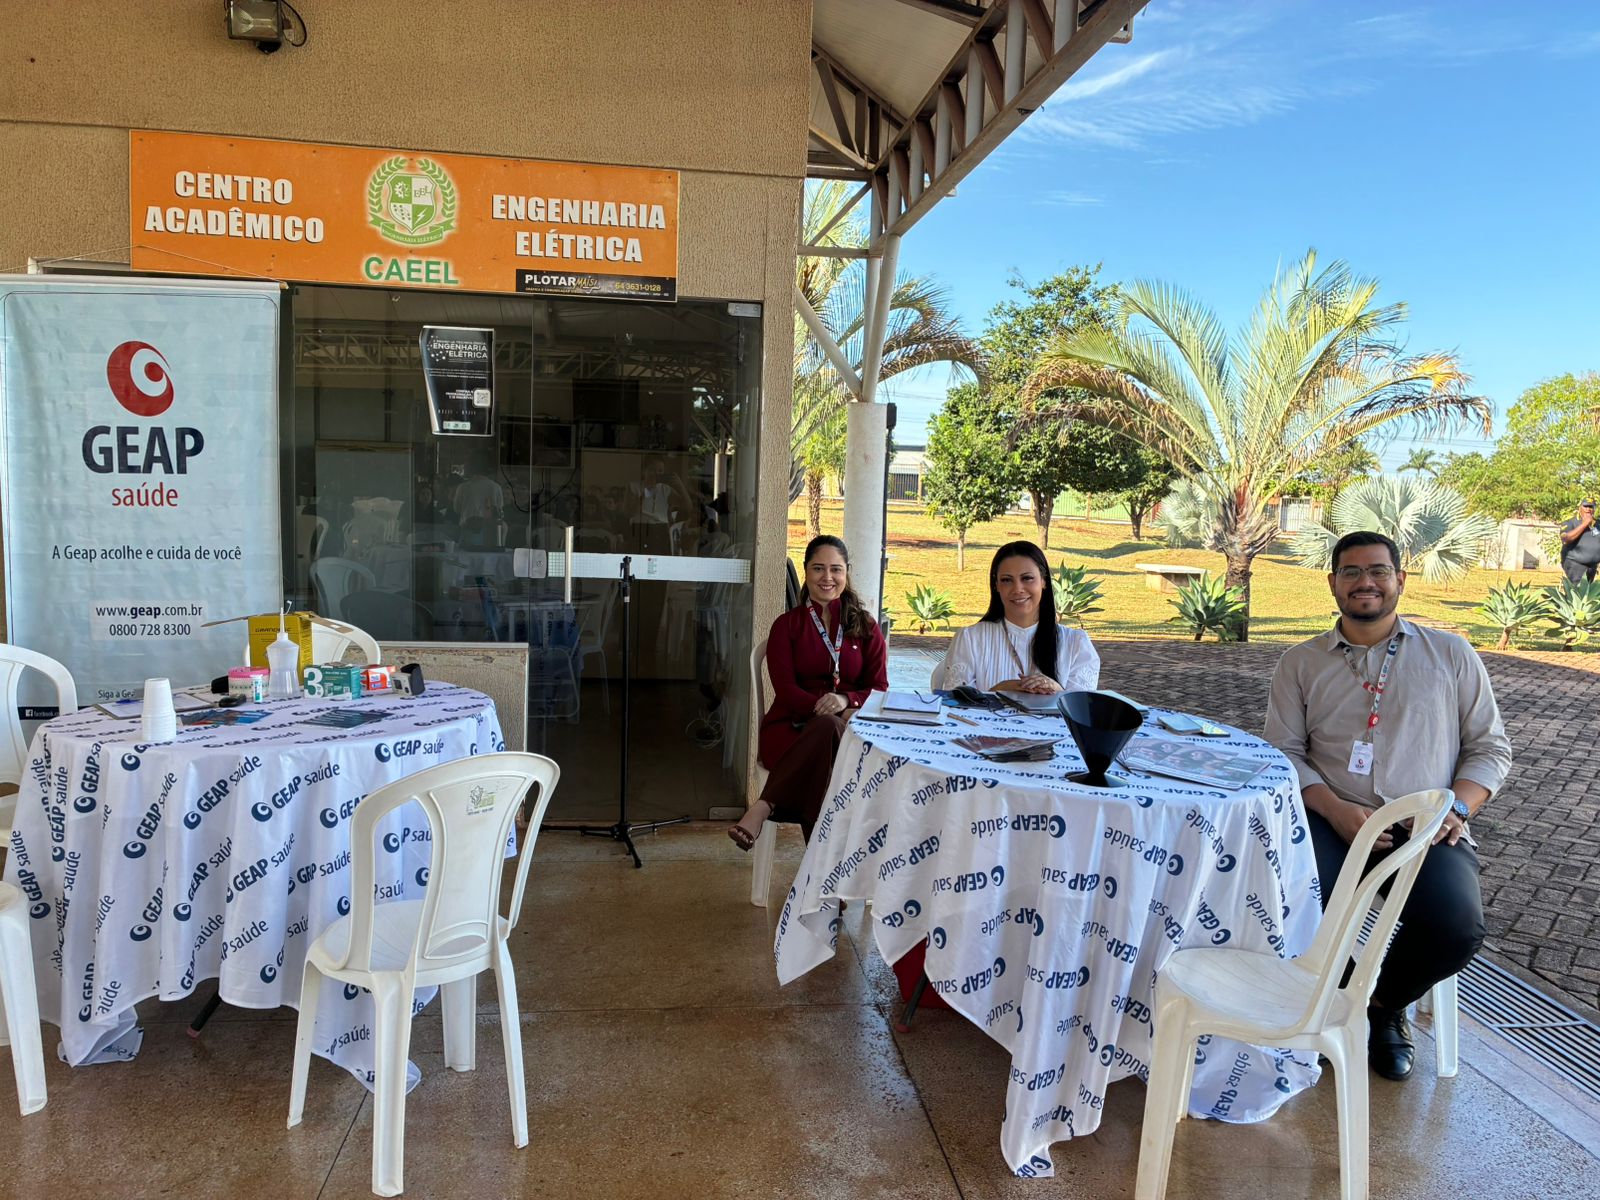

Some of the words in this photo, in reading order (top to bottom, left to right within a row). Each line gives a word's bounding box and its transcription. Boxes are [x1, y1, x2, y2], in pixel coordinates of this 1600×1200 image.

[175, 170, 293, 204] CENTRO
[144, 206, 324, 243] ACADÊMICO
[492, 194, 666, 229] ENGENHARIA
[516, 229, 643, 263] ELÉTRICA
[364, 256, 459, 284] CAEEL
[525, 274, 576, 286] PLOTAR
[433, 342, 487, 351] ENGENHARIA
[449, 349, 488, 358] ELÉTRICA
[82, 425, 204, 475] GEAP
[111, 482, 178, 507] saúde
[52, 546, 61, 560] A
[64, 545, 97, 562] Geap
[100, 545, 142, 560] acolhe
[146, 549, 153, 560] e
[157, 545, 191, 560] cuida
[194, 545, 210, 560] de
[214, 546, 242, 560] você
[96, 603, 203, 619] www.geap.com.br
[109, 624, 137, 636] 0800
[140, 624, 160, 636] 728
[163, 624, 191, 636] 8300
[98, 689, 114, 700] Siga
[304, 667, 325, 698] 3
[393, 739, 421, 757] GEAP
[54, 765, 69, 806] saúde
[196, 779, 231, 813] GEAP
[229, 755, 263, 786] saúde
[271, 775, 302, 810] GEAP
[304, 761, 341, 787] saúde
[861, 766, 888, 800] saúde
[911, 781, 944, 806] saúde
[945, 775, 977, 795] GEAP
[339, 794, 369, 820] GEA
[51, 805, 66, 843] GEAP
[136, 803, 161, 840] GEAP
[411, 826, 432, 842] saú
[971, 815, 1009, 839] saúde
[1011, 814, 1050, 832] GEAP
[11, 830, 31, 867] saúde
[909, 835, 941, 866] GEAP
[1103, 826, 1144, 853] saúde
[64, 850, 82, 891] saúde
[232, 858, 269, 892] GEAP
[878, 853, 907, 881] saúd
[1041, 866, 1067, 887] saú
[18, 868, 43, 901] GEAP
[187, 861, 210, 902] GEAP
[932, 877, 952, 898] saú
[953, 871, 988, 893] GEAP
[1068, 872, 1101, 892] GEAP
[143, 887, 164, 924] GEAP
[1245, 892, 1277, 940] saúde
[194, 912, 226, 951] saúde
[229, 918, 270, 953] saúde
[1106, 936, 1140, 964] GEAP
[961, 968, 992, 995] GEAP
[1045, 972, 1078, 989] GEAP
[1122, 996, 1151, 1025] GEA
[338, 1024, 371, 1047] saúde
[1027, 1069, 1055, 1091] GEAP
